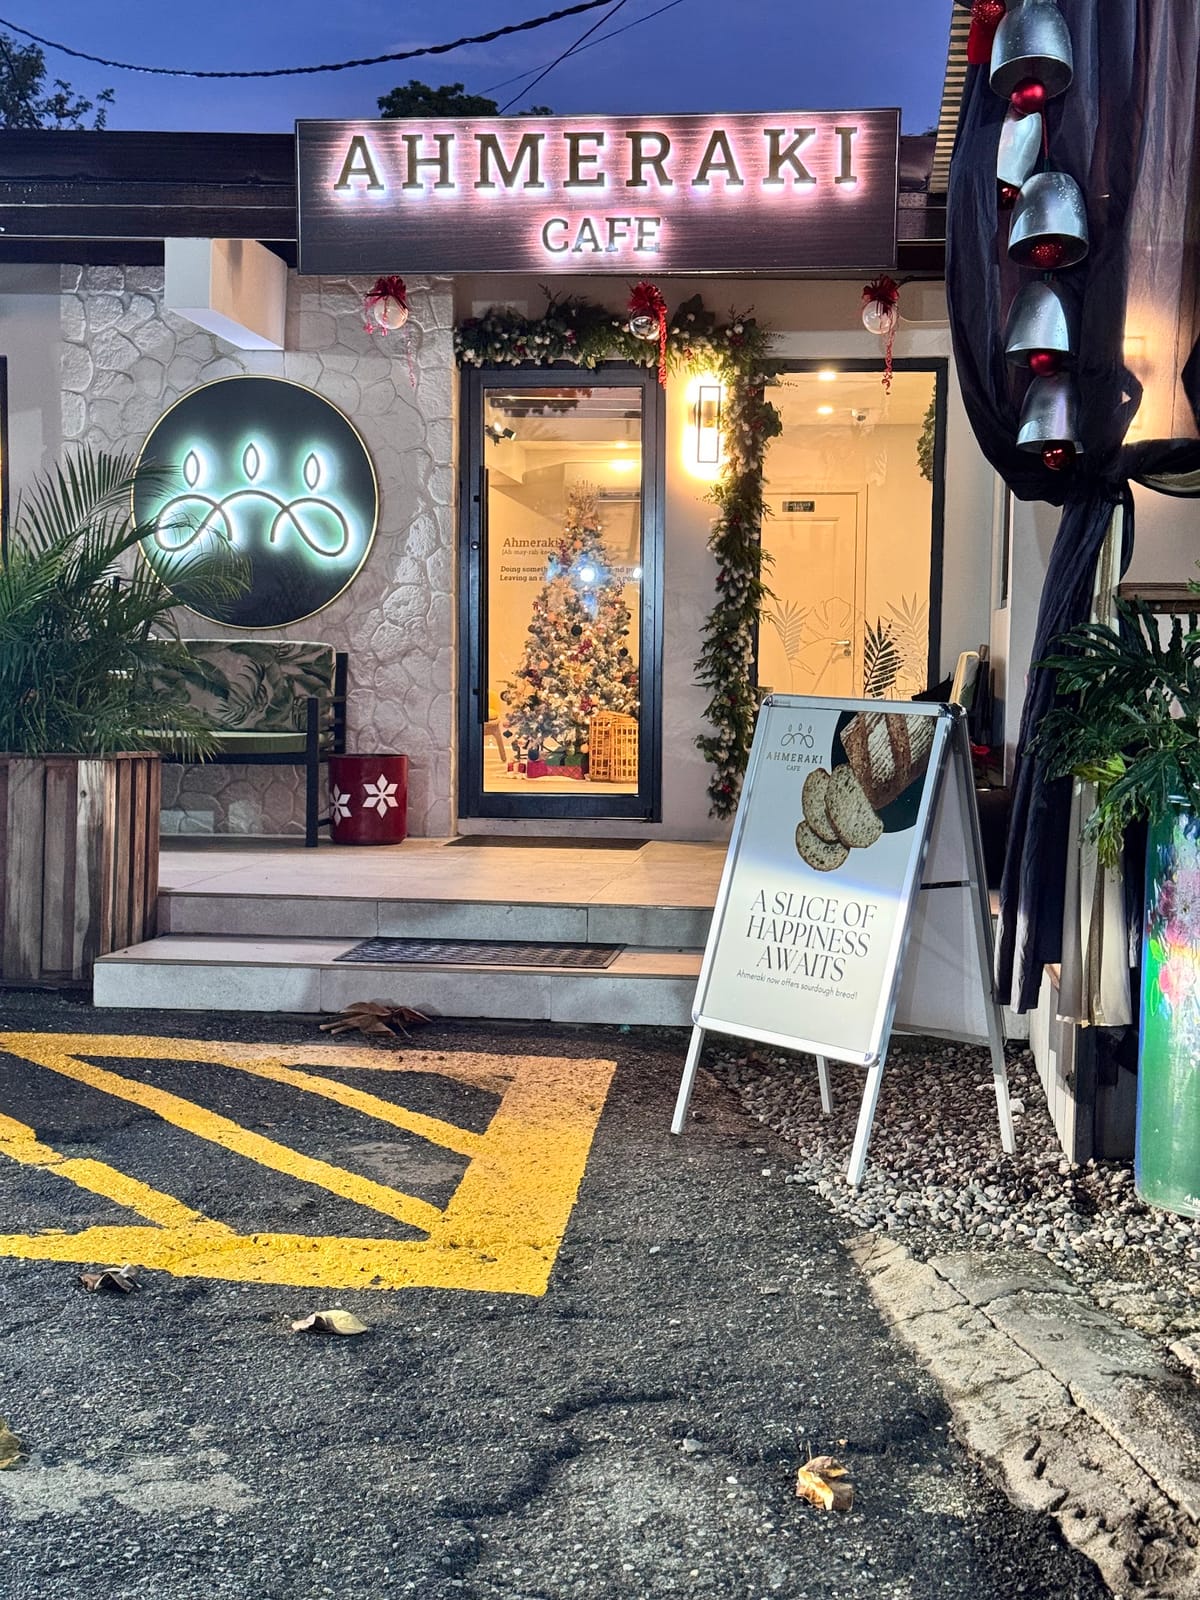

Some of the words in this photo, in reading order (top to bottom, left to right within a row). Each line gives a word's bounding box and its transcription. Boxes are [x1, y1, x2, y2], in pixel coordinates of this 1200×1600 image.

[332, 126, 859, 191] AHMERAKI
[541, 216, 661, 254] CAFE
[499, 574, 527, 582] Leaving
[500, 565, 521, 574] Doing
[766, 751, 823, 764] AHMERAKI
[786, 764, 801, 772] CAFE
[750, 889, 767, 913] A
[771, 891, 839, 924] SLICE
[843, 901, 878, 929] OF
[746, 915, 871, 958] HAPPINESS
[756, 945, 847, 982] AWAITS
[736, 968, 767, 983] Ahmeraki
[766, 977, 780, 986] now
[781, 978, 800, 989] offers
[800, 982, 835, 997] sourdough
[835, 986, 859, 1000] bread!
